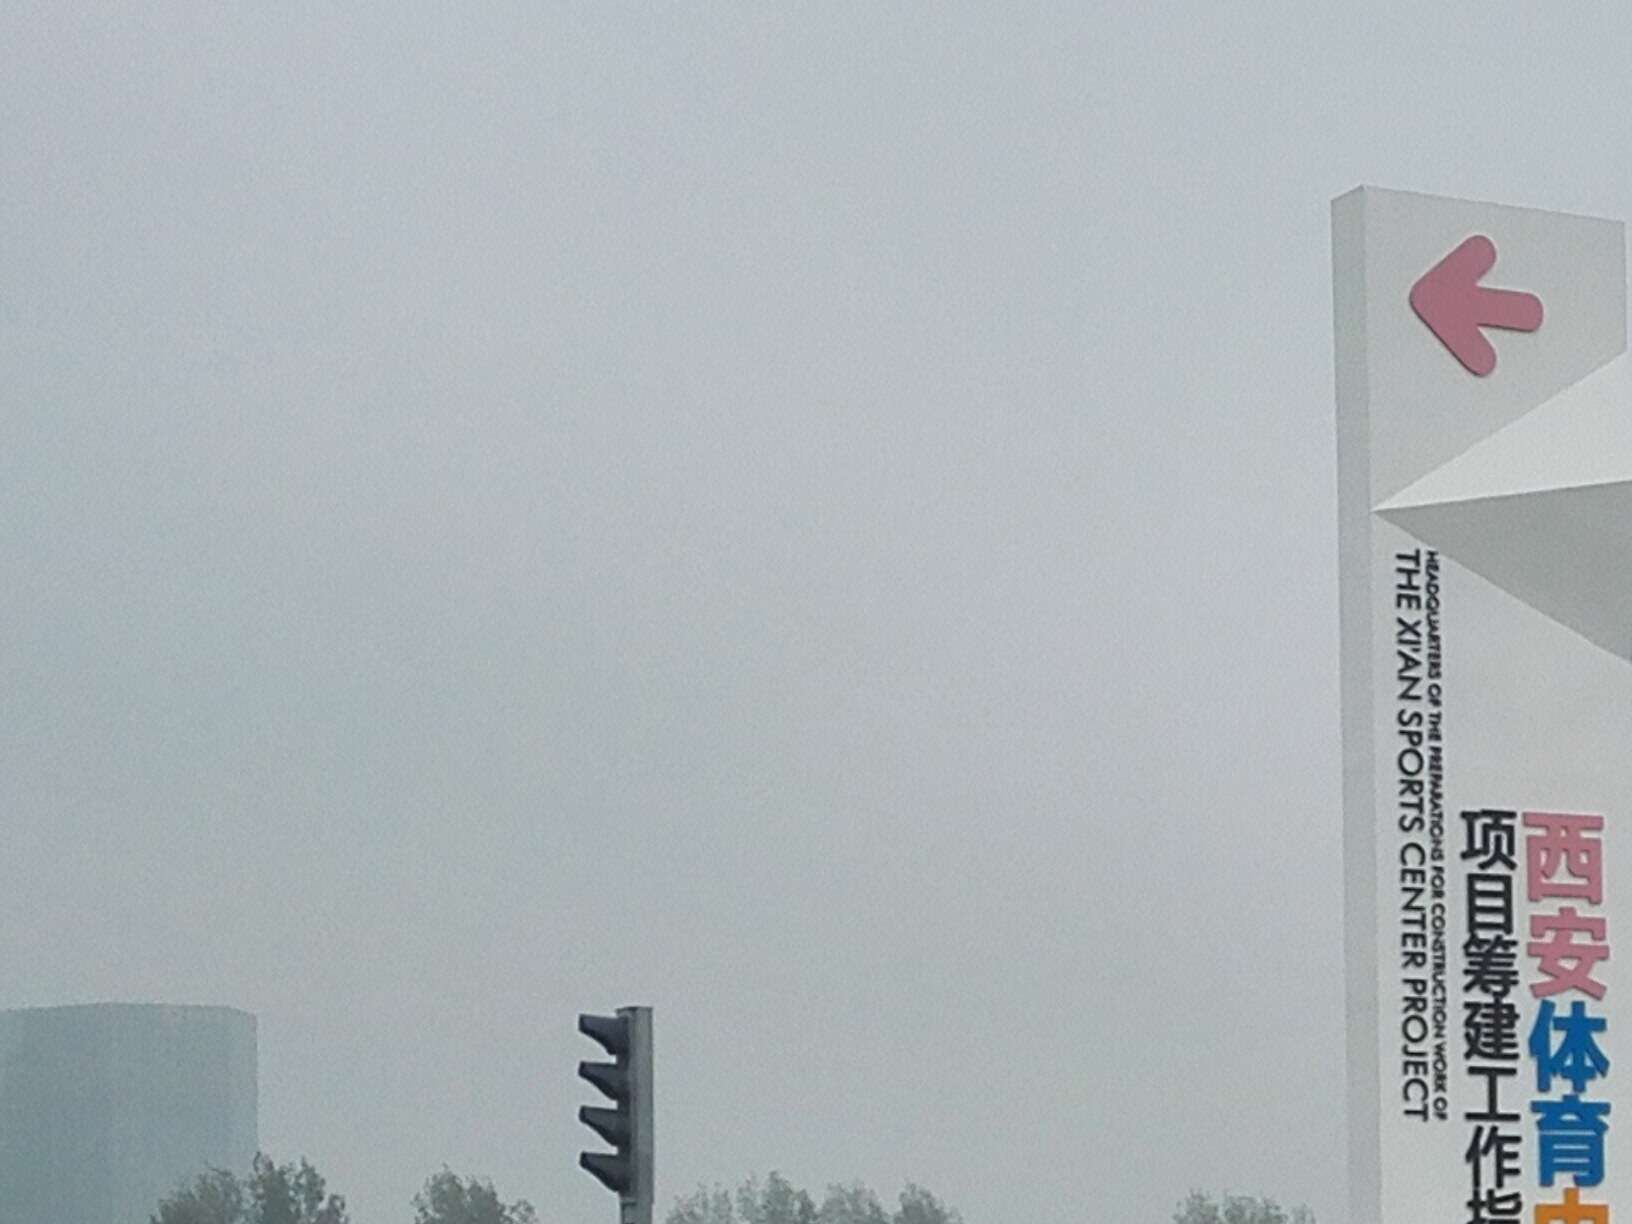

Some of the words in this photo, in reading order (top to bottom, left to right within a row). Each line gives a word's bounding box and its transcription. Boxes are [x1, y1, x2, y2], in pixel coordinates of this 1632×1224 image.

[1396, 549, 1421, 610] THE
[1426, 551, 1441, 679] HEADQUARTERS
[1397, 617, 1422, 700] XI'AN
[1428, 684, 1442, 707] OF
[1428, 712, 1442, 741] THE
[1398, 709, 1424, 832] SPORTS
[1429, 746, 1444, 861] PREPARATIONS
[1400, 843, 1428, 968] CENTER
[1432, 866, 1444, 898] FOR
[1431, 903, 1446, 1038] CONSTRUCTION
[1402, 979, 1429, 1122] PROJECT
[1433, 1043, 1447, 1092] WORK
[1434, 1097, 1447, 1120] OF
